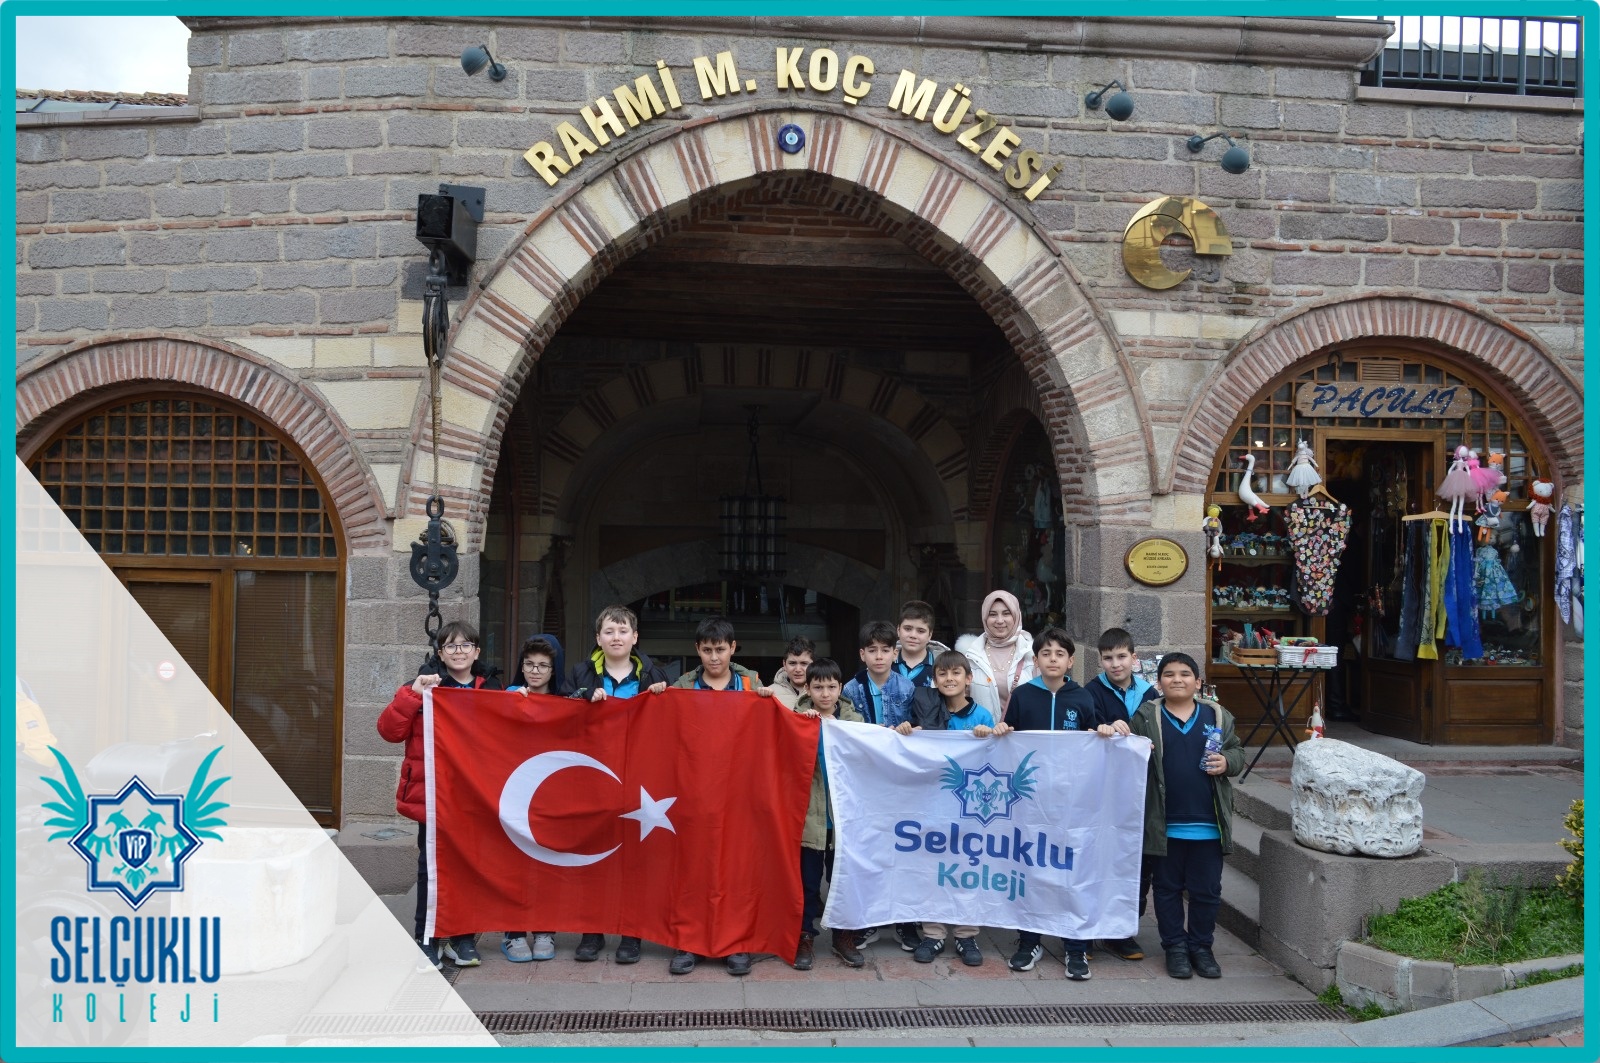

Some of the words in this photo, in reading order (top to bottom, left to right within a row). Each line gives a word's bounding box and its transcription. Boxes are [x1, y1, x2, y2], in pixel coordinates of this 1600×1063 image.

[523, 60, 682, 187] RAHMİ
[693, 51, 757, 99] M.
[776, 46, 874, 105] KOÇ
[888, 68, 1063, 201] MÜZESİ
[894, 820, 1074, 871] Selçuklu
[937, 861, 1025, 901] Koleji
